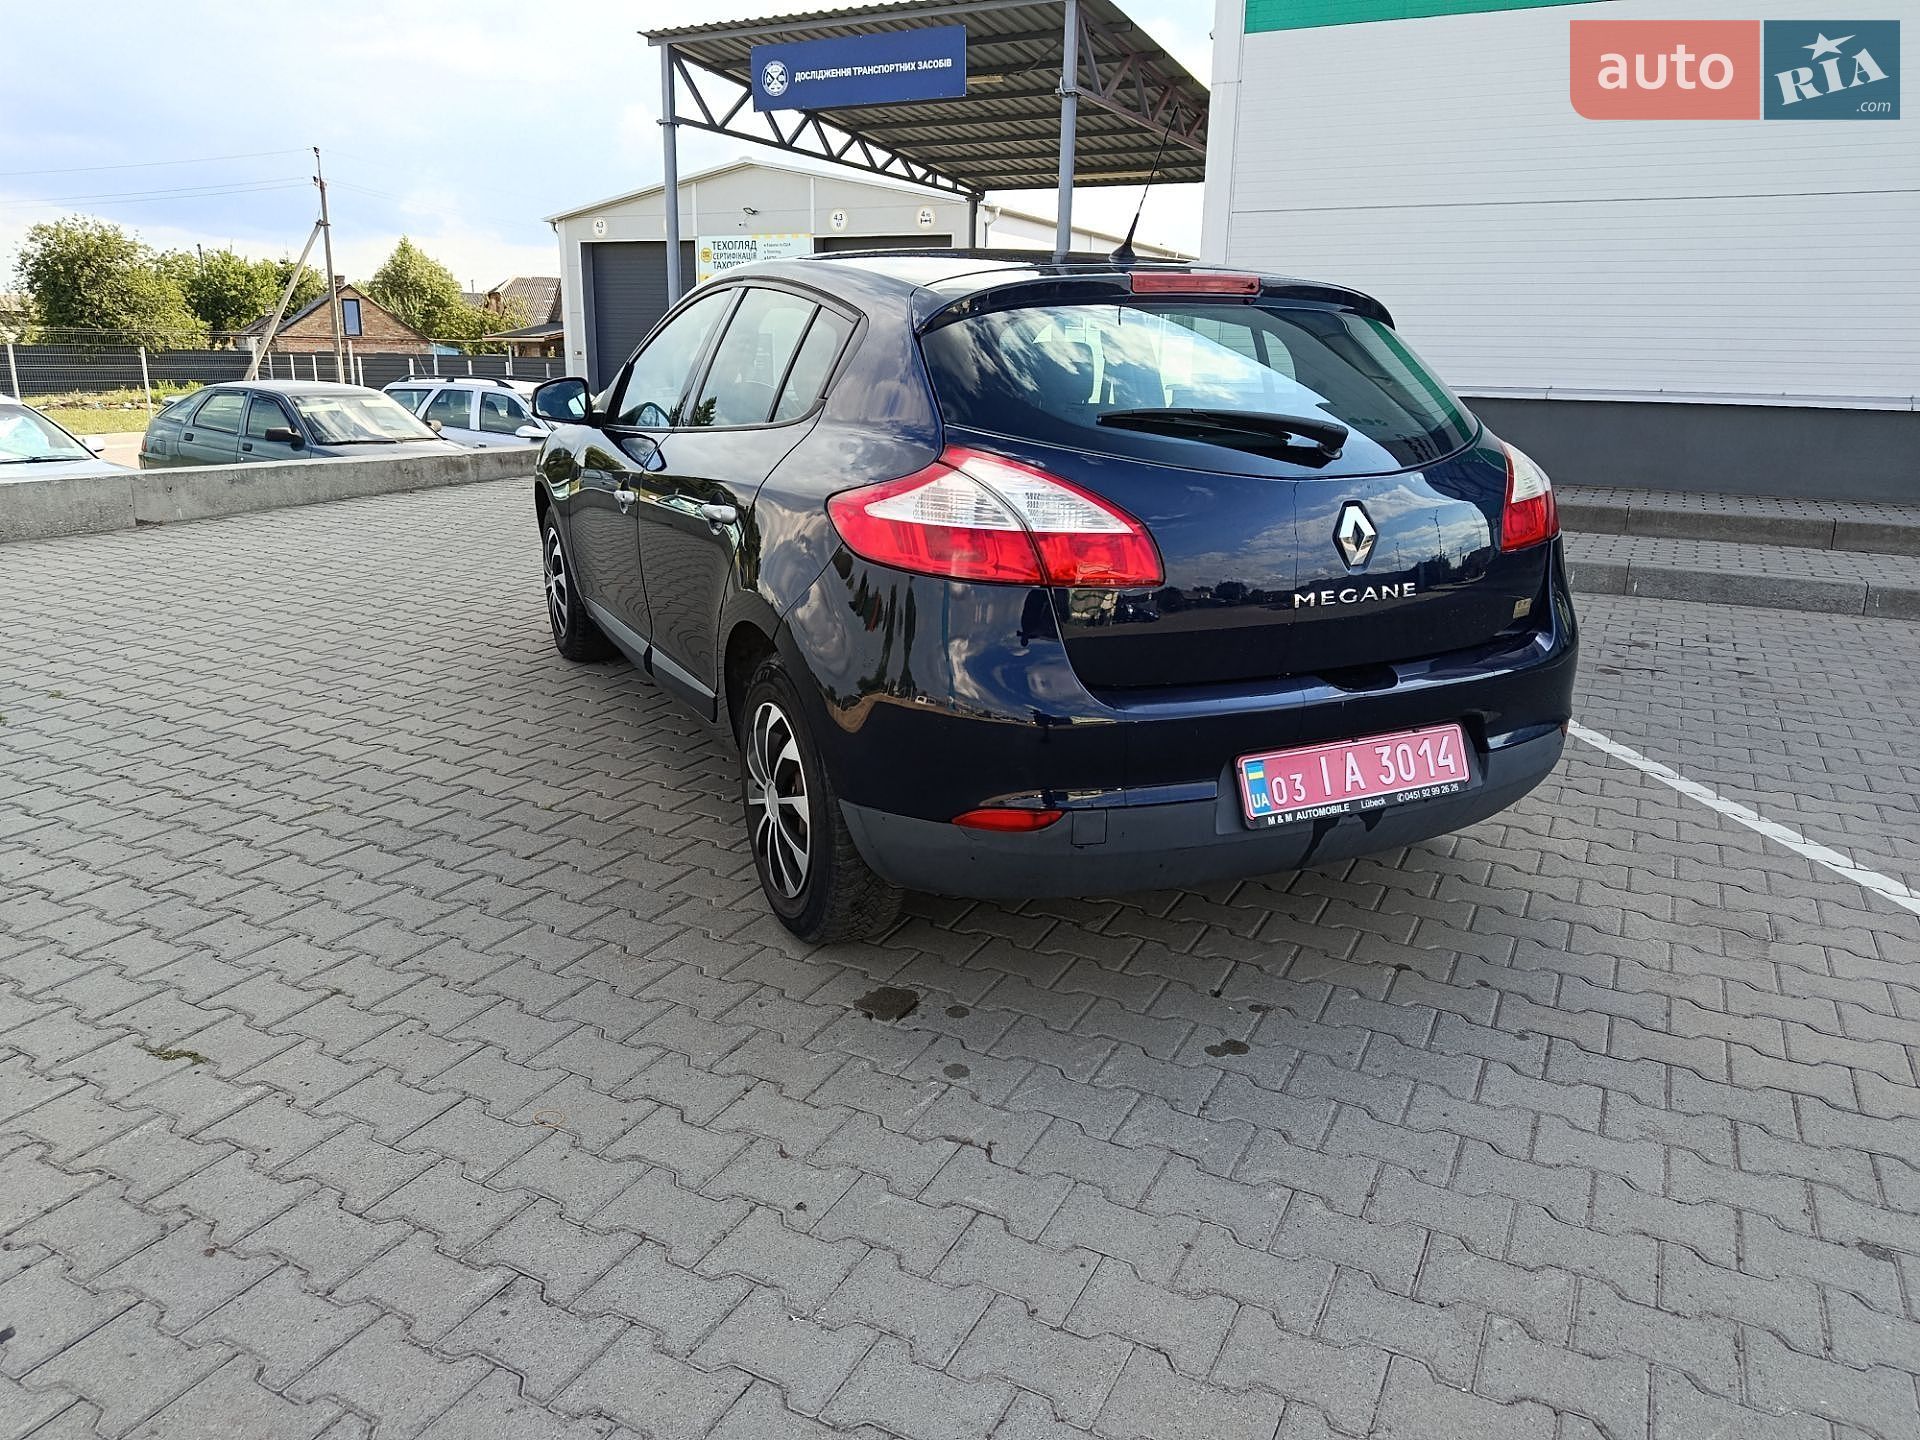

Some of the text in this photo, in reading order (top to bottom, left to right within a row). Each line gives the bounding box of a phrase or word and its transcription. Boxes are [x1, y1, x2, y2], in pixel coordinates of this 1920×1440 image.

[794, 67, 852, 83] ДОСЛІДЖЕННЯ
[852, 62, 916, 77] ТРАНСПОРТНИХ
[917, 58, 952, 70] ЗАСОБІВ
[712, 240, 757, 251] ТЕХОГЛЯД
[1294, 583, 1417, 608] MEGANE
[1271, 773, 1306, 804] 03
[1375, 736, 1456, 785] 3014
[1252, 793, 1270, 808] UA
[1267, 816, 1276, 826] M
[1277, 815, 1285, 824] &
[1285, 813, 1293, 822] M
[1296, 803, 1350, 821] AUTOMOBILE
[1360, 797, 1386, 809] Lübeck
